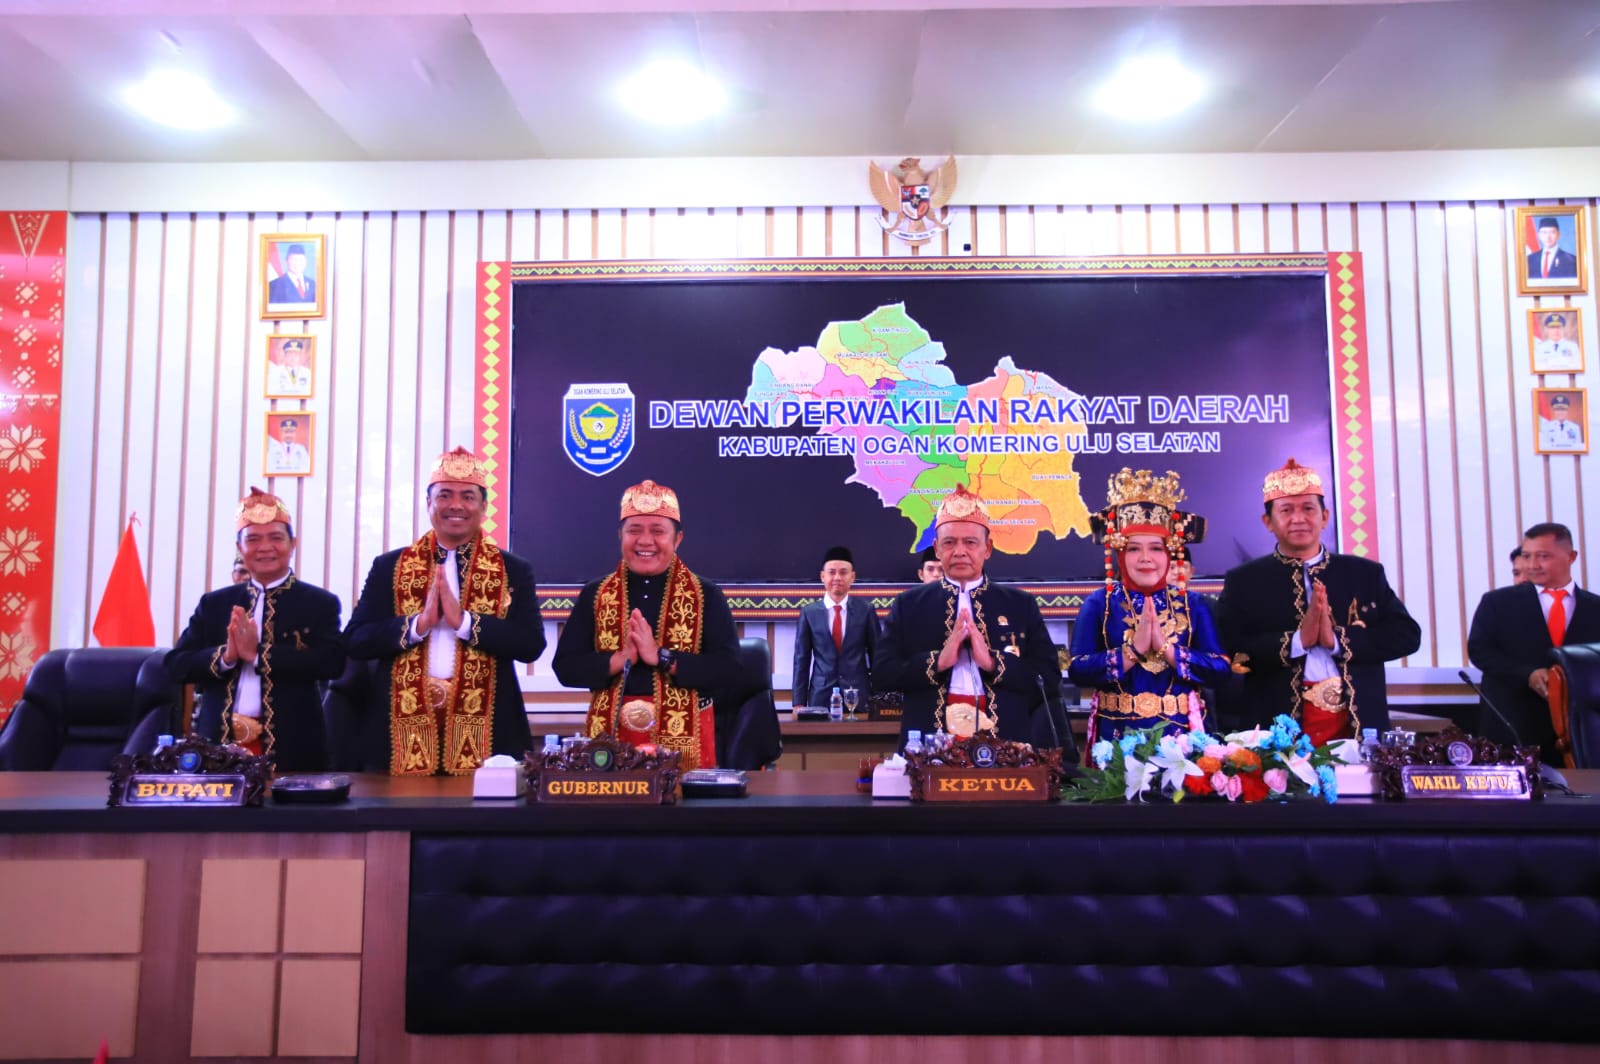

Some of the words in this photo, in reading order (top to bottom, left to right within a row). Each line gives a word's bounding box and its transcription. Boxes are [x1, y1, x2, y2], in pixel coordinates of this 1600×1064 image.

[650, 400, 770, 428] DEWAN
[782, 398, 999, 427] PERWAKILAN
[1009, 396, 1140, 425] RAKYAT
[1149, 395, 1290, 423] DAERAH
[719, 436, 856, 457] KABUPATEN
[863, 435, 930, 456] OGAN
[937, 434, 1060, 455] KOMERING
[1065, 433, 1111, 453] ULU
[1116, 432, 1221, 453] SELATAN
[136, 783, 234, 798] BUPATI
[548, 781, 650, 796] GUBERNUR
[938, 777, 1035, 792] KETUA
[1411, 776, 1461, 790] WAKIL
[1465, 776, 1516, 791] KETUA
